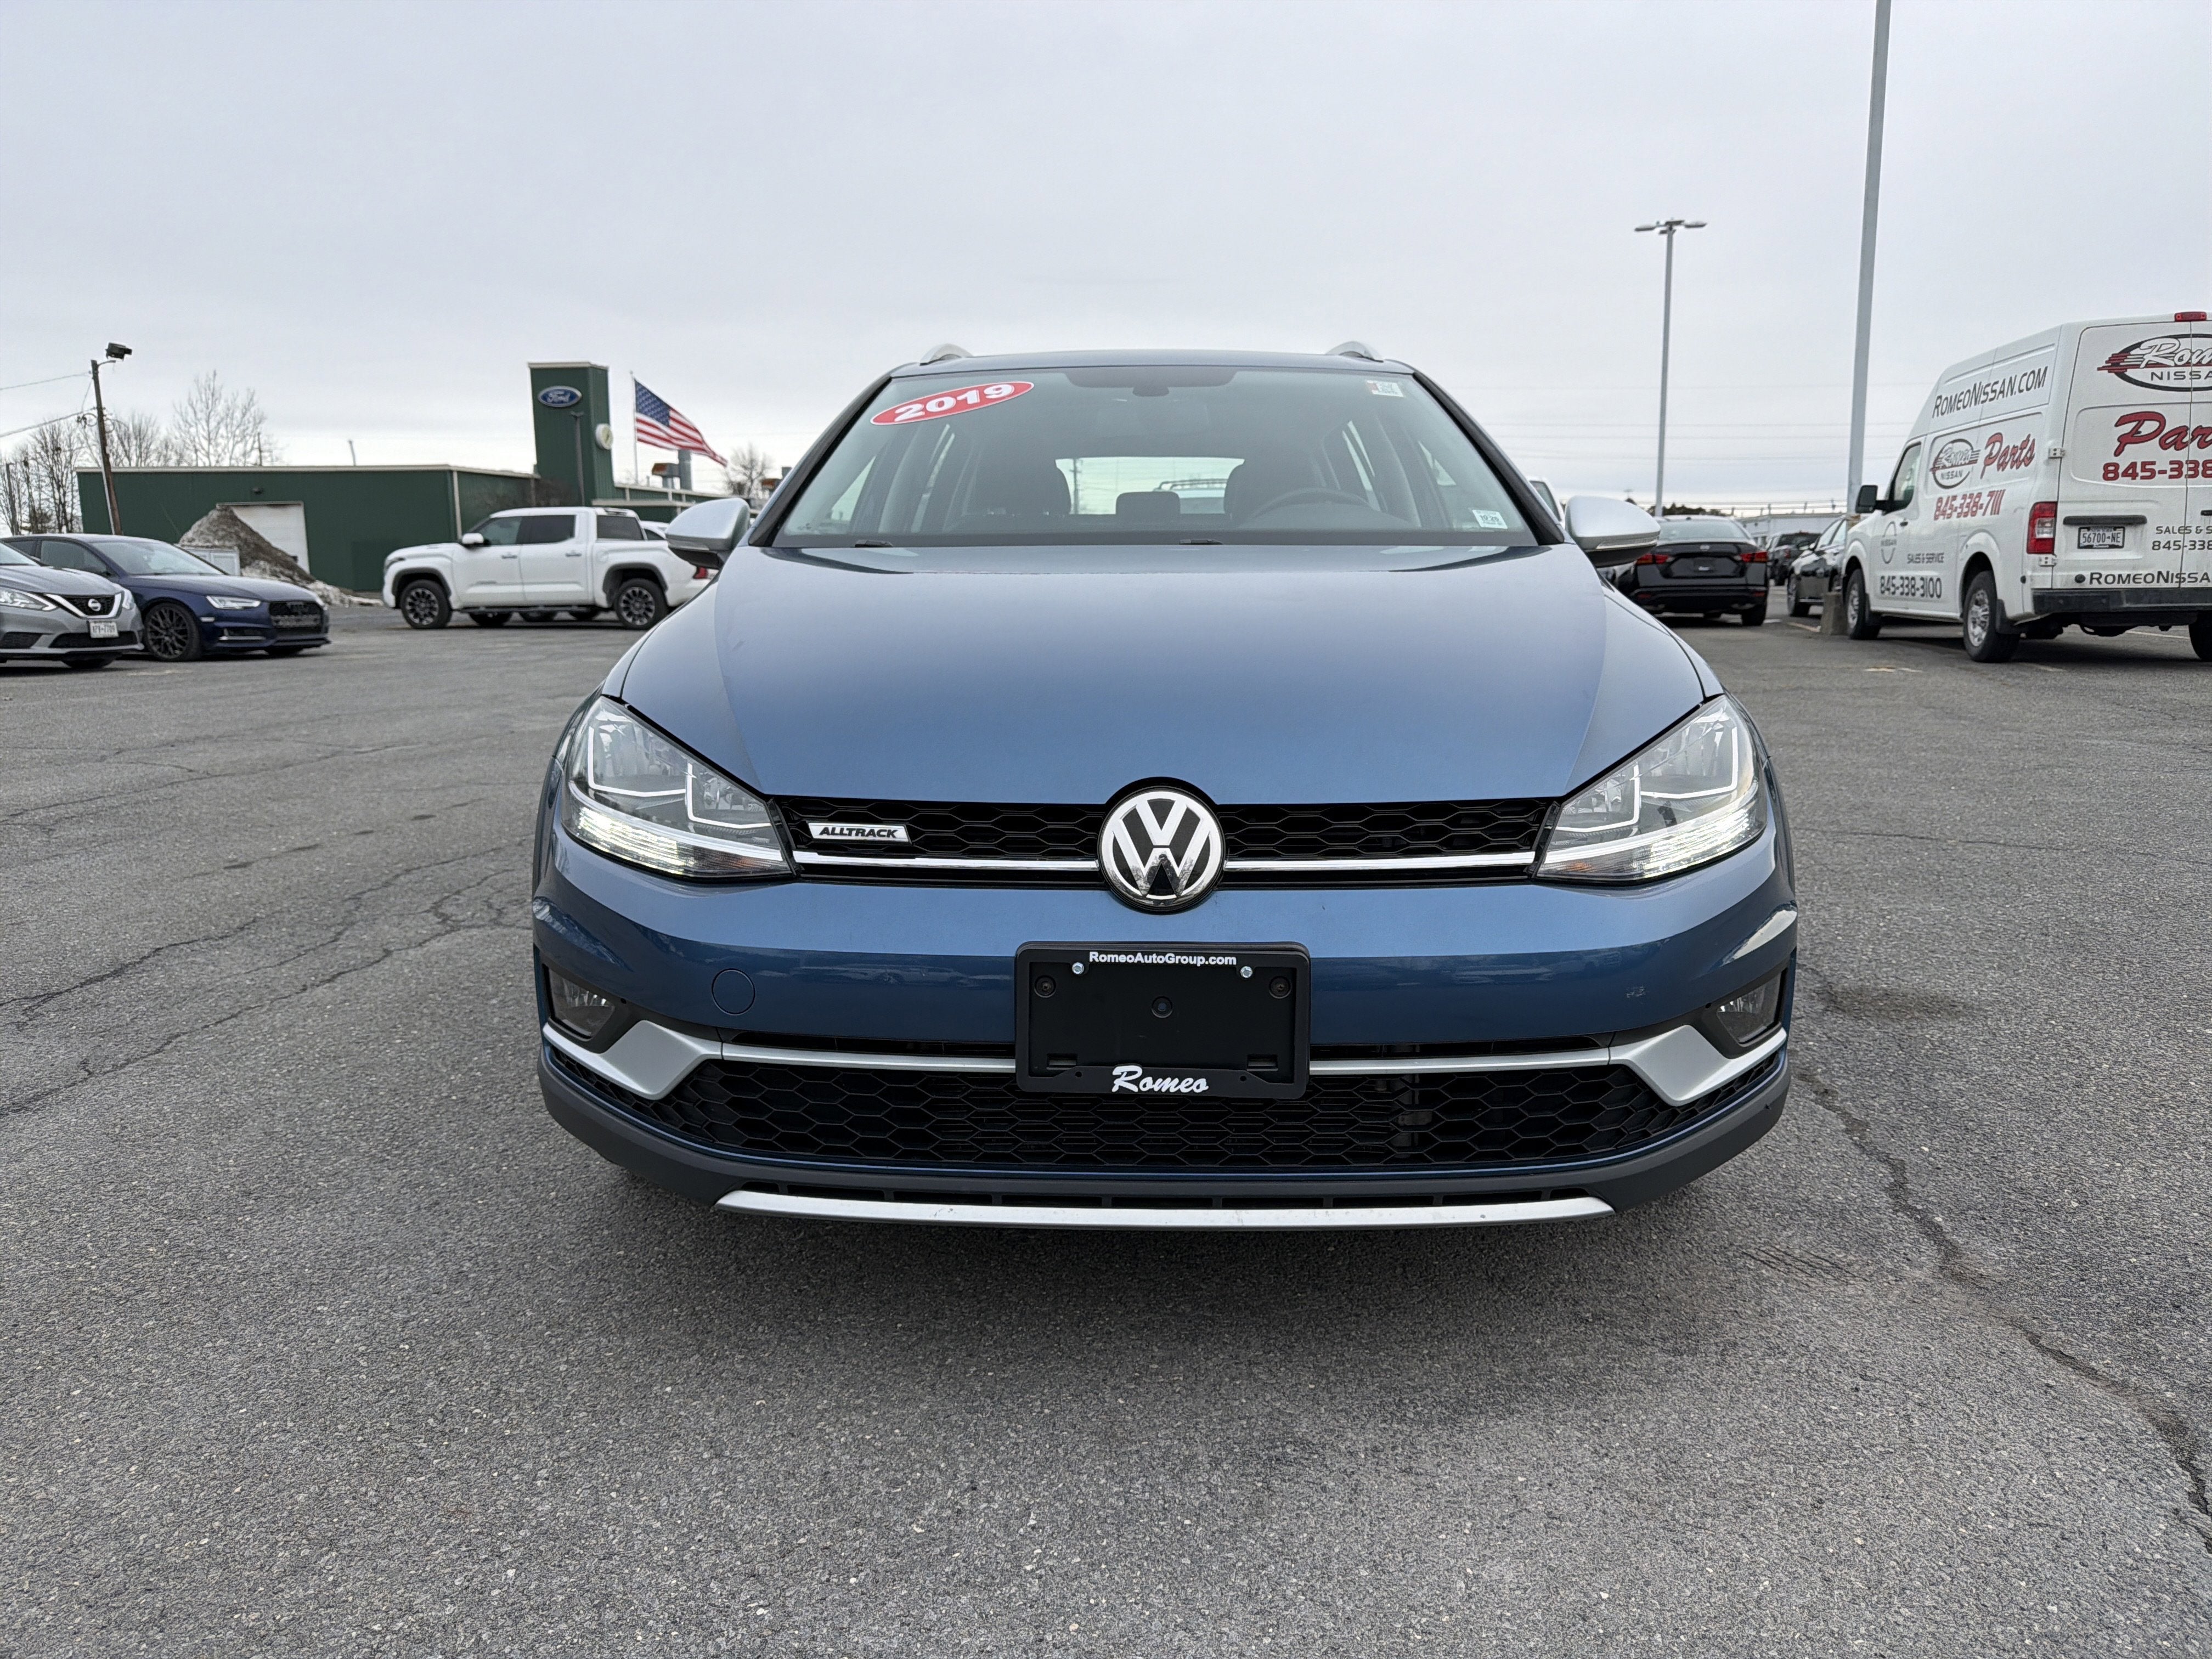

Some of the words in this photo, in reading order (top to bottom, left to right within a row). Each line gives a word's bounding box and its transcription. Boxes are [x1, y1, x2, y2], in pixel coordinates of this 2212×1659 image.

[546, 390, 571, 403] Ford
[894, 384, 1015, 422] 2019
[1980, 432, 2035, 479] Parts
[2155, 526, 2192, 534] SALES
[2195, 526, 2203, 534] &
[1881, 575, 1942, 599] 845-338-3100
[819, 827, 898, 838] ALLTRACK
[1089, 951, 1237, 967] RomeoAutoGroup.com
[1111, 1065, 1209, 1093] Romeo
